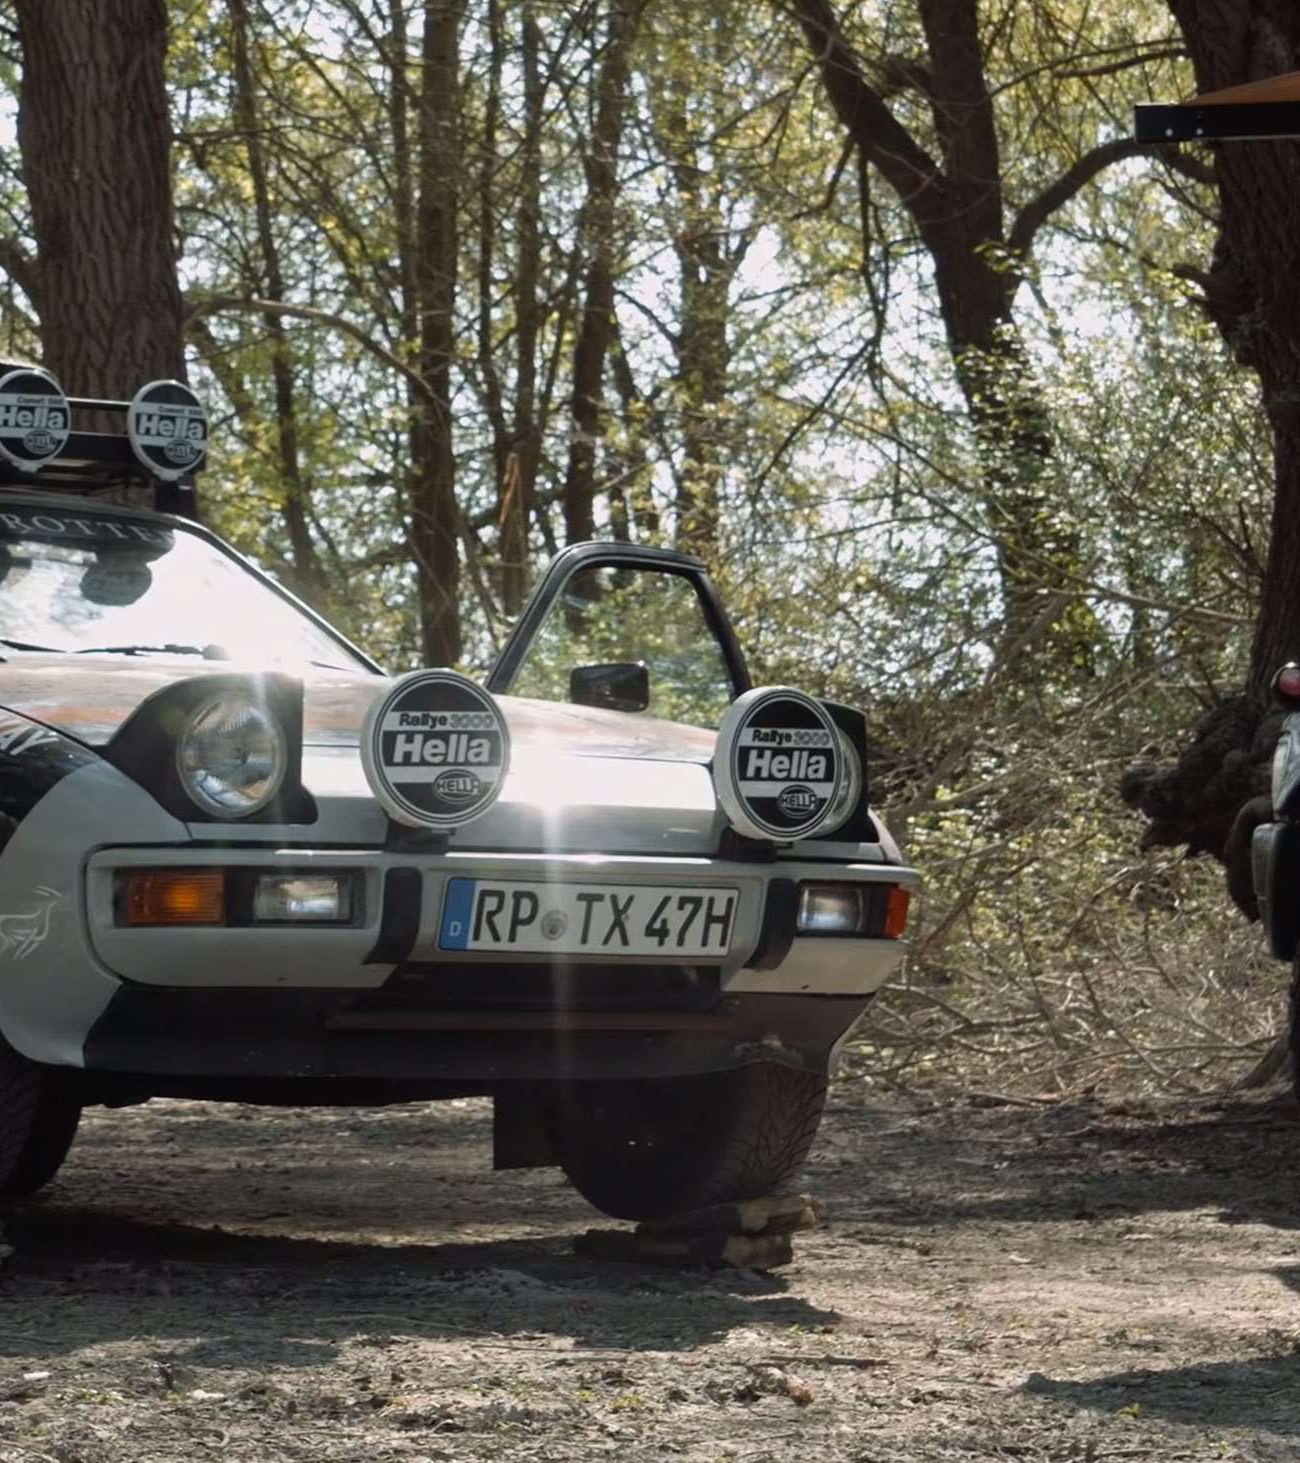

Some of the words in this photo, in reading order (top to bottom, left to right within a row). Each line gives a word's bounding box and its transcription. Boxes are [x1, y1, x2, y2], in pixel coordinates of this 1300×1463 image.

[138, 414, 204, 440] Hella
[399, 712, 448, 729] Rallye
[450, 713, 494, 729] 3000
[392, 733, 492, 764] Hella
[751, 729, 792, 746] Rallye
[746, 749, 827, 780] Hella
[449, 921, 461, 936] D
[472, 889, 540, 943] RP
[576, 892, 635, 946] TX
[644, 895, 735, 948] 47H
